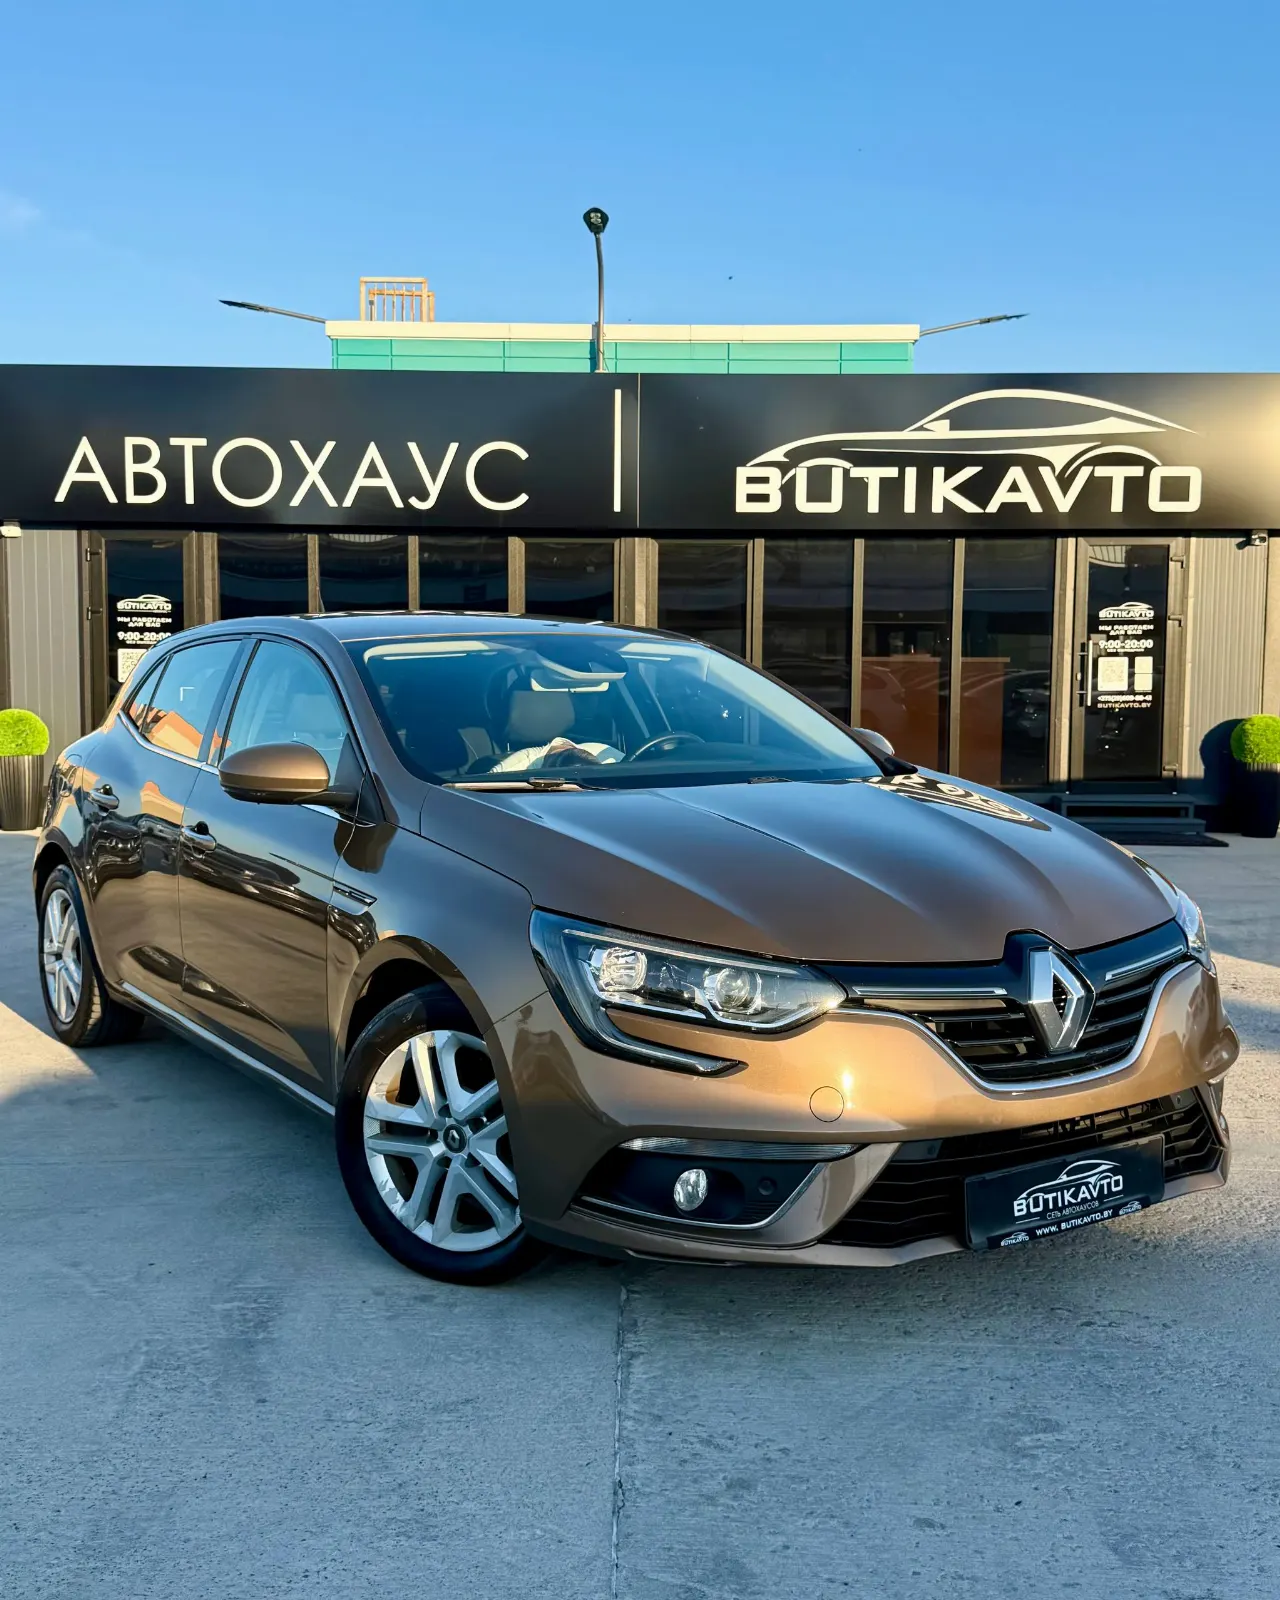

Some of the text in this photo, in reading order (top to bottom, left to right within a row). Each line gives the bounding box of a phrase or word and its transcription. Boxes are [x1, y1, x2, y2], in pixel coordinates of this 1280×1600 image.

[54, 436, 530, 511] АВТОХАУС
[735, 466, 1203, 514] BUTIKAVTO
[1098, 639, 1154, 649] 9:00-20:00
[1013, 1175, 1124, 1217] BUTIKAVTO
[1046, 1200, 1099, 1220] СЕТЬ АВТОХАУСОВ
[1035, 1209, 1113, 1236] WWW. BUTIKAVTO.BY
